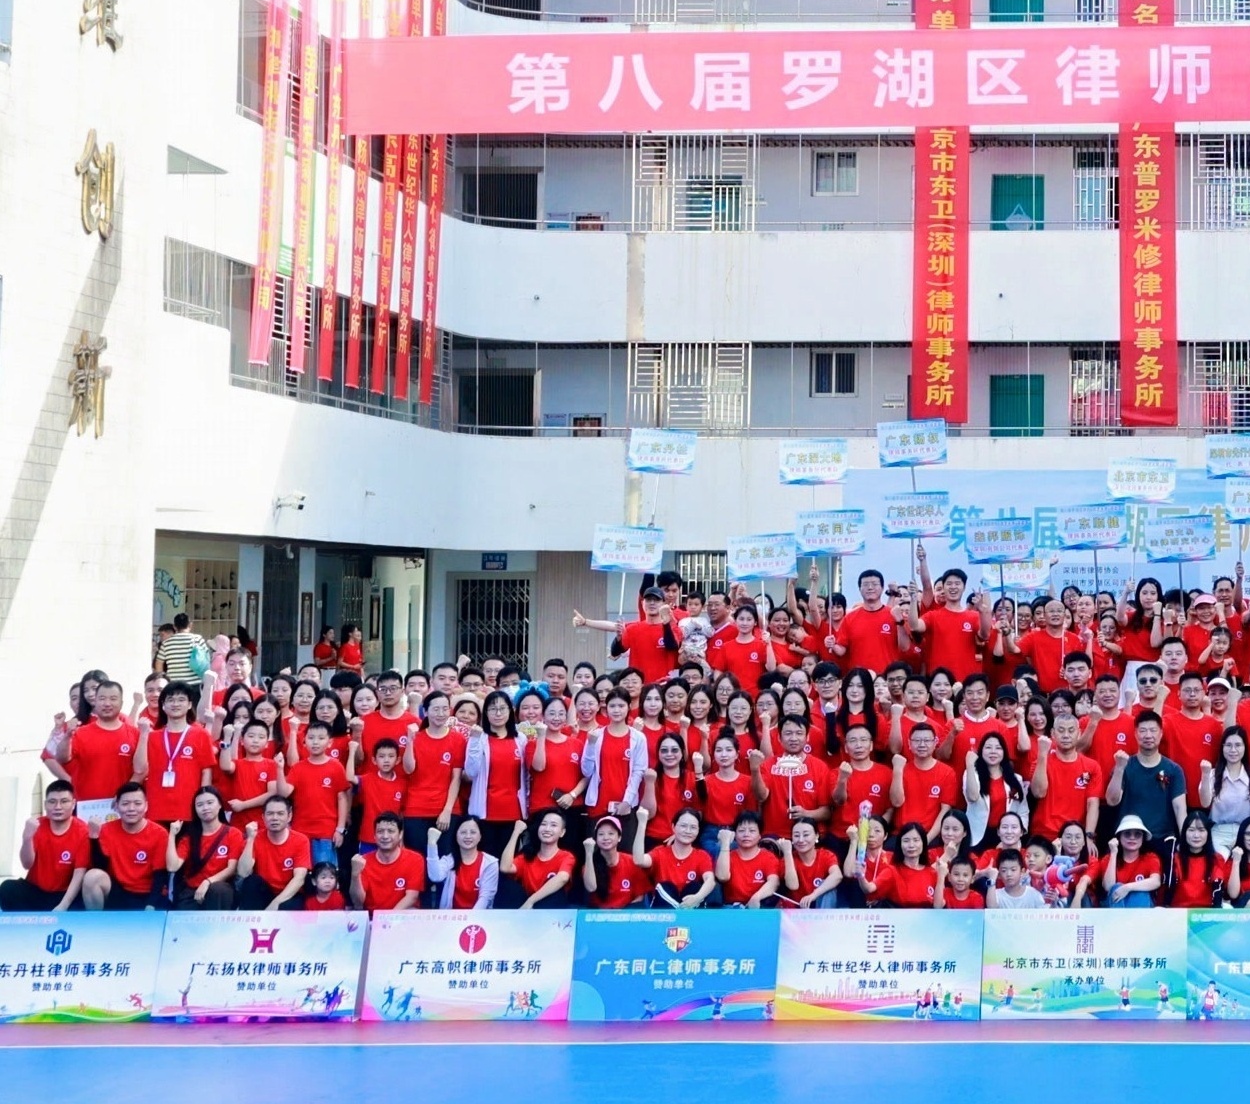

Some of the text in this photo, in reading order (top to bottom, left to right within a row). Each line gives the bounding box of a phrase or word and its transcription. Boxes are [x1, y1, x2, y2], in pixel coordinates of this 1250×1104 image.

[1132, 122, 1164, 408] 东普罗米修律师事务所
[190, 961, 328, 977] 广东扬权律师事务所
[399, 960, 542, 975] 广东高帜律师事务所
[595, 959, 756, 976] 广东同仁律师事务所
[802, 960, 957, 974] 广东世纪华人律师事务所
[1003, 957, 1167, 970] 北京市东卫（深圳）律师事务所
[237, 981, 277, 991] 赞助单位
[448, 980, 489, 989] 赞助单位
[653, 980, 695, 990] 赞助单位
[858, 979, 899, 989] 赞助单位
[1064, 976, 1105, 986] 承办单位
[32, 982, 73, 992] 赞助单位
